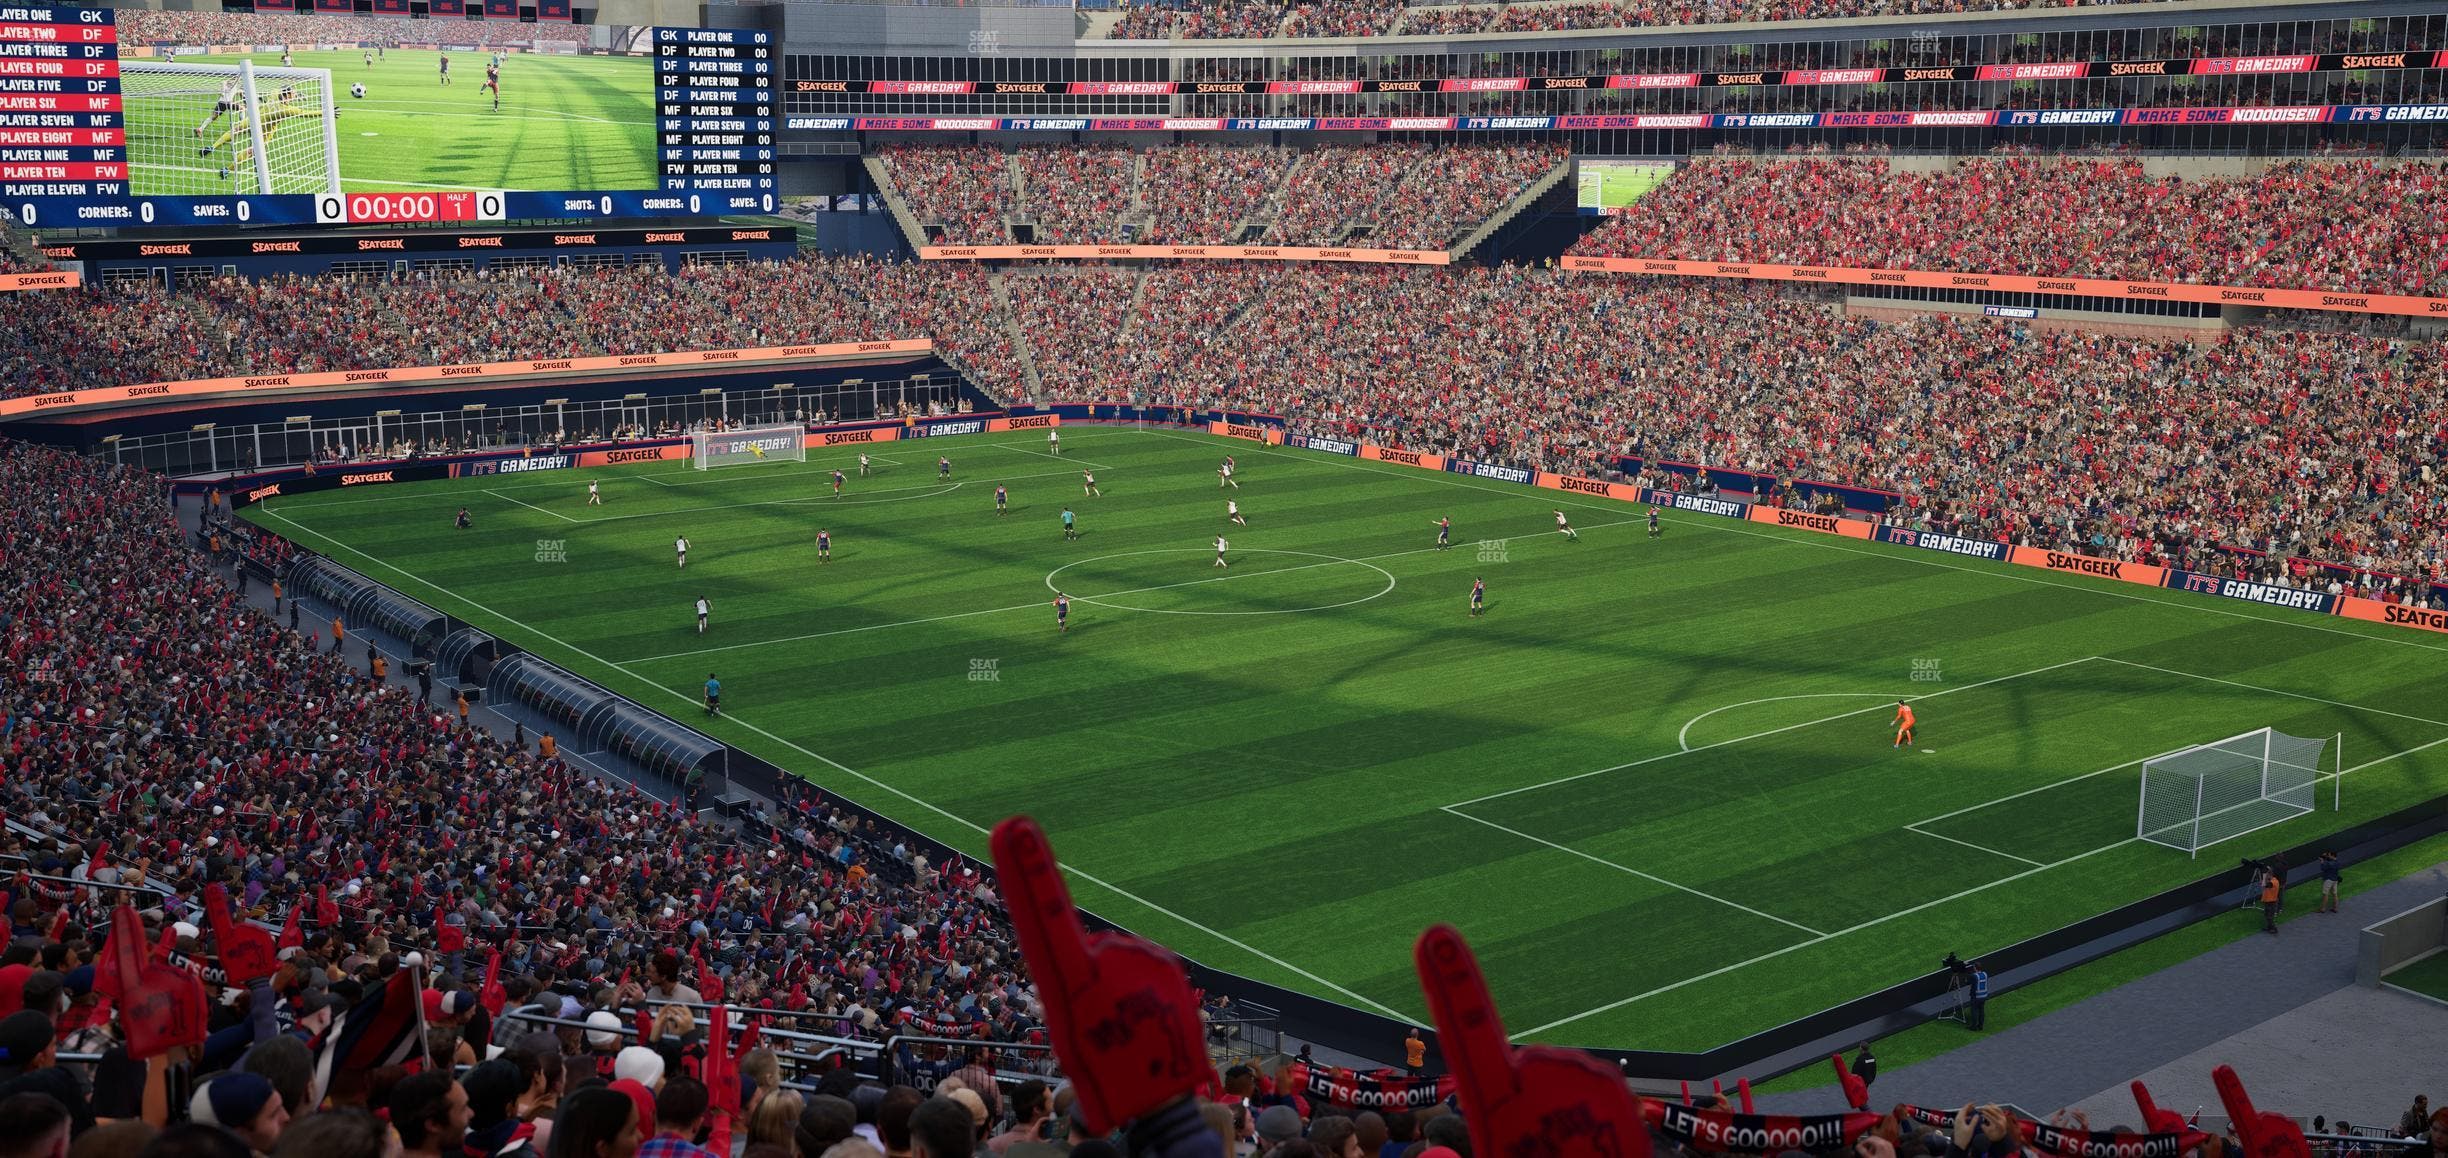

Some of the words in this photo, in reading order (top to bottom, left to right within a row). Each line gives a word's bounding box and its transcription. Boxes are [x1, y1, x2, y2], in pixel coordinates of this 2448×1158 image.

[31, 10, 52, 21] ONE
[80, 11, 102, 22] GK
[33, 28, 56, 39] TWO
[83, 29, 102, 40] DF
[661, 31, 677, 41] GK
[688, 32, 717, 42] PLAYER
[717, 32, 733, 42] ONE
[755, 33, 766, 43] 00
[34, 45, 68, 57] THREE
[84, 46, 104, 57] DF
[2207, 60, 2231, 72] IT'S
[2235, 58, 2304, 71] GAMEDAY!
[2341, 54, 2406, 67] SEATGEEK
[36, 62, 63, 74] FOUR
[86, 63, 105, 75] DF
[1904, 67, 1954, 80] SEATGEEK
[1992, 67, 2011, 78] IT'S
[2015, 64, 2076, 77] GAMEDAY!
[2110, 62, 2166, 75] SEATGEEK
[663, 76, 678, 86] DF
[690, 76, 718, 86] PLAYER
[719, 77, 739, 87] FOUR
[757, 78, 768, 88] 00
[1619, 76, 1637, 87] IT'S
[1639, 75, 1691, 86] GAMEDAY!
[1717, 73, 1762, 85] SEATGEEK
[38, 80, 61, 91] FIVE
[88, 81, 107, 91] DF
[797, 81, 847, 92] SEATGEEK
[884, 81, 905, 92] IT'S
[907, 81, 964, 92] GAMEDAY!
[1378, 80, 1421, 91] SEATGEEK
[39, 98, 56, 108] SIX
[89, 98, 110, 109] MF
[1832, 115, 1870, 125] MAKE
[1873, 115, 1908, 125] SOME
[1912, 112, 1986, 124] NOOOOISE!!!
[2010, 112, 2037, 123] IT'S
[2040, 111, 2116, 124] GAMEDAY!
[2136, 110, 2181, 122] MAKE
[2186, 110, 2229, 122] SOME
[2230, 108, 2320, 122] NOOOOISE!!!
[2349, 107, 2381, 120] IT'S
[0, 115, 38, 126] PLAYER
[41, 115, 74, 126] SEVEN
[91, 115, 111, 126] MF
[788, 119, 848, 129] GAMEDAY!
[865, 119, 899, 129] MAKE
[902, 119, 931, 129] SOME
[1237, 119, 1256, 129] IT'S
[1258, 119, 1311, 129] GAMEDAY!
[1467, 118, 1488, 128] IT'S
[1491, 117, 1550, 128] GAMEDAY!
[1723, 116, 1746, 126] IT'S
[1748, 114, 1813, 126] GAMEDAY!
[1, 132, 40, 143] PLAYER
[42, 132, 72, 143] EIGHT
[92, 132, 112, 143] MF
[2, 150, 41, 161] PLAYER
[44, 150, 69, 160] NINE
[94, 150, 114, 160] MF
[4, 167, 43, 177] PLAYER
[45, 167, 65, 177] TEN
[95, 166, 118, 177] FW
[5, 185, 45, 195] PLAYER
[47, 185, 86, 195] ELEVEN
[96, 184, 119, 195] FW
[668, 179, 685, 189] FW
[694, 179, 722, 189] PLAYER
[724, 179, 751, 189] ELEVEN
[760, 179, 772, 188] 00
[446, 194, 468, 202] HALF
[322, 198, 341, 219] 0
[352, 196, 435, 219] 00:00
[454, 202, 461, 217] 1
[483, 196, 500, 216] 0
[565, 200, 596, 212] SHOTS:
[643, 198, 684, 209] CORNERS:
[730, 198, 757, 208] SAVES:
[78, 206, 133, 219] CORNERS:
[194, 205, 230, 217] SAVES:
[554, 233, 596, 245] SEATGEEK
[732, 230, 770, 241] SEATGEEK
[252, 241, 300, 253] SEATGEEK
[459, 236, 502, 248] SEATGEEK
[141, 243, 192, 255] SEATGEEK
[940, 249, 976, 257] SEATGEEK
[1099, 248, 1131, 256] SEATGEEK
[1644, 262, 1677, 272] SEATGEEK
[17, 275, 67, 286] SEATGEEK
[1870, 272, 1906, 283] SEATGEEK
[1952, 276, 1990, 287] SEATGEEK
[2127, 285, 2168, 297] SEATGEEK
[2221, 290, 2265, 302] SEATGEEK
[2322, 296, 2368, 308] SEATGEEK
[858, 343, 891, 351] SEATGEEK
[620, 355, 657, 365] SEATGEEK
[441, 366, 482, 375] SEATGEEK
[245, 376, 289, 387] SEATGEEK
[128, 385, 169, 397] SEATGEEK
[1009, 415, 1051, 429] SEATGEEK
[908, 425, 928, 439] IT'S
[930, 421, 981, 437] GAMEDAY!
[1227, 424, 1263, 441] SEATGEEK
[825, 431, 873, 446] SEATGEEK
[1290, 435, 1307, 449] IT'S
[1308, 438, 1354, 456] GAMEDAY!
[607, 447, 663, 465] SEATGEEK
[1379, 448, 1422, 467] SEATGEEK
[472, 461, 497, 476] IT'S
[500, 455, 567, 474] GAMEDAY!
[341, 471, 394, 486] SEATGEEK
[1454, 461, 1474, 475] IT'S
[1475, 463, 1529, 484] GAMEDAY!
[1560, 475, 1611, 498] SEATGEEK
[1651, 490, 1673, 507] IT'S
[1675, 494, 1740, 518] GAMEDAY!
[1778, 510, 1839, 534] SEATGEEK
[1888, 528, 1917, 546] IT'S
[1919, 533, 1999, 559] GAMEDAY!
[2046, 551, 2122, 579] SEATGEEK
[2183, 574, 2220, 595] IT'S
[2222, 579, 2324, 612] GAMEDAY!
[1307, 1075, 1348, 1103] LET'S
[1350, 1084, 1436, 1107] GOOOOO!!!
[1663, 1105, 1719, 1143] LET'S
[1722, 1119, 1842, 1149] GOOOOO!!!
[2033, 1125, 2079, 1153] LET'S
